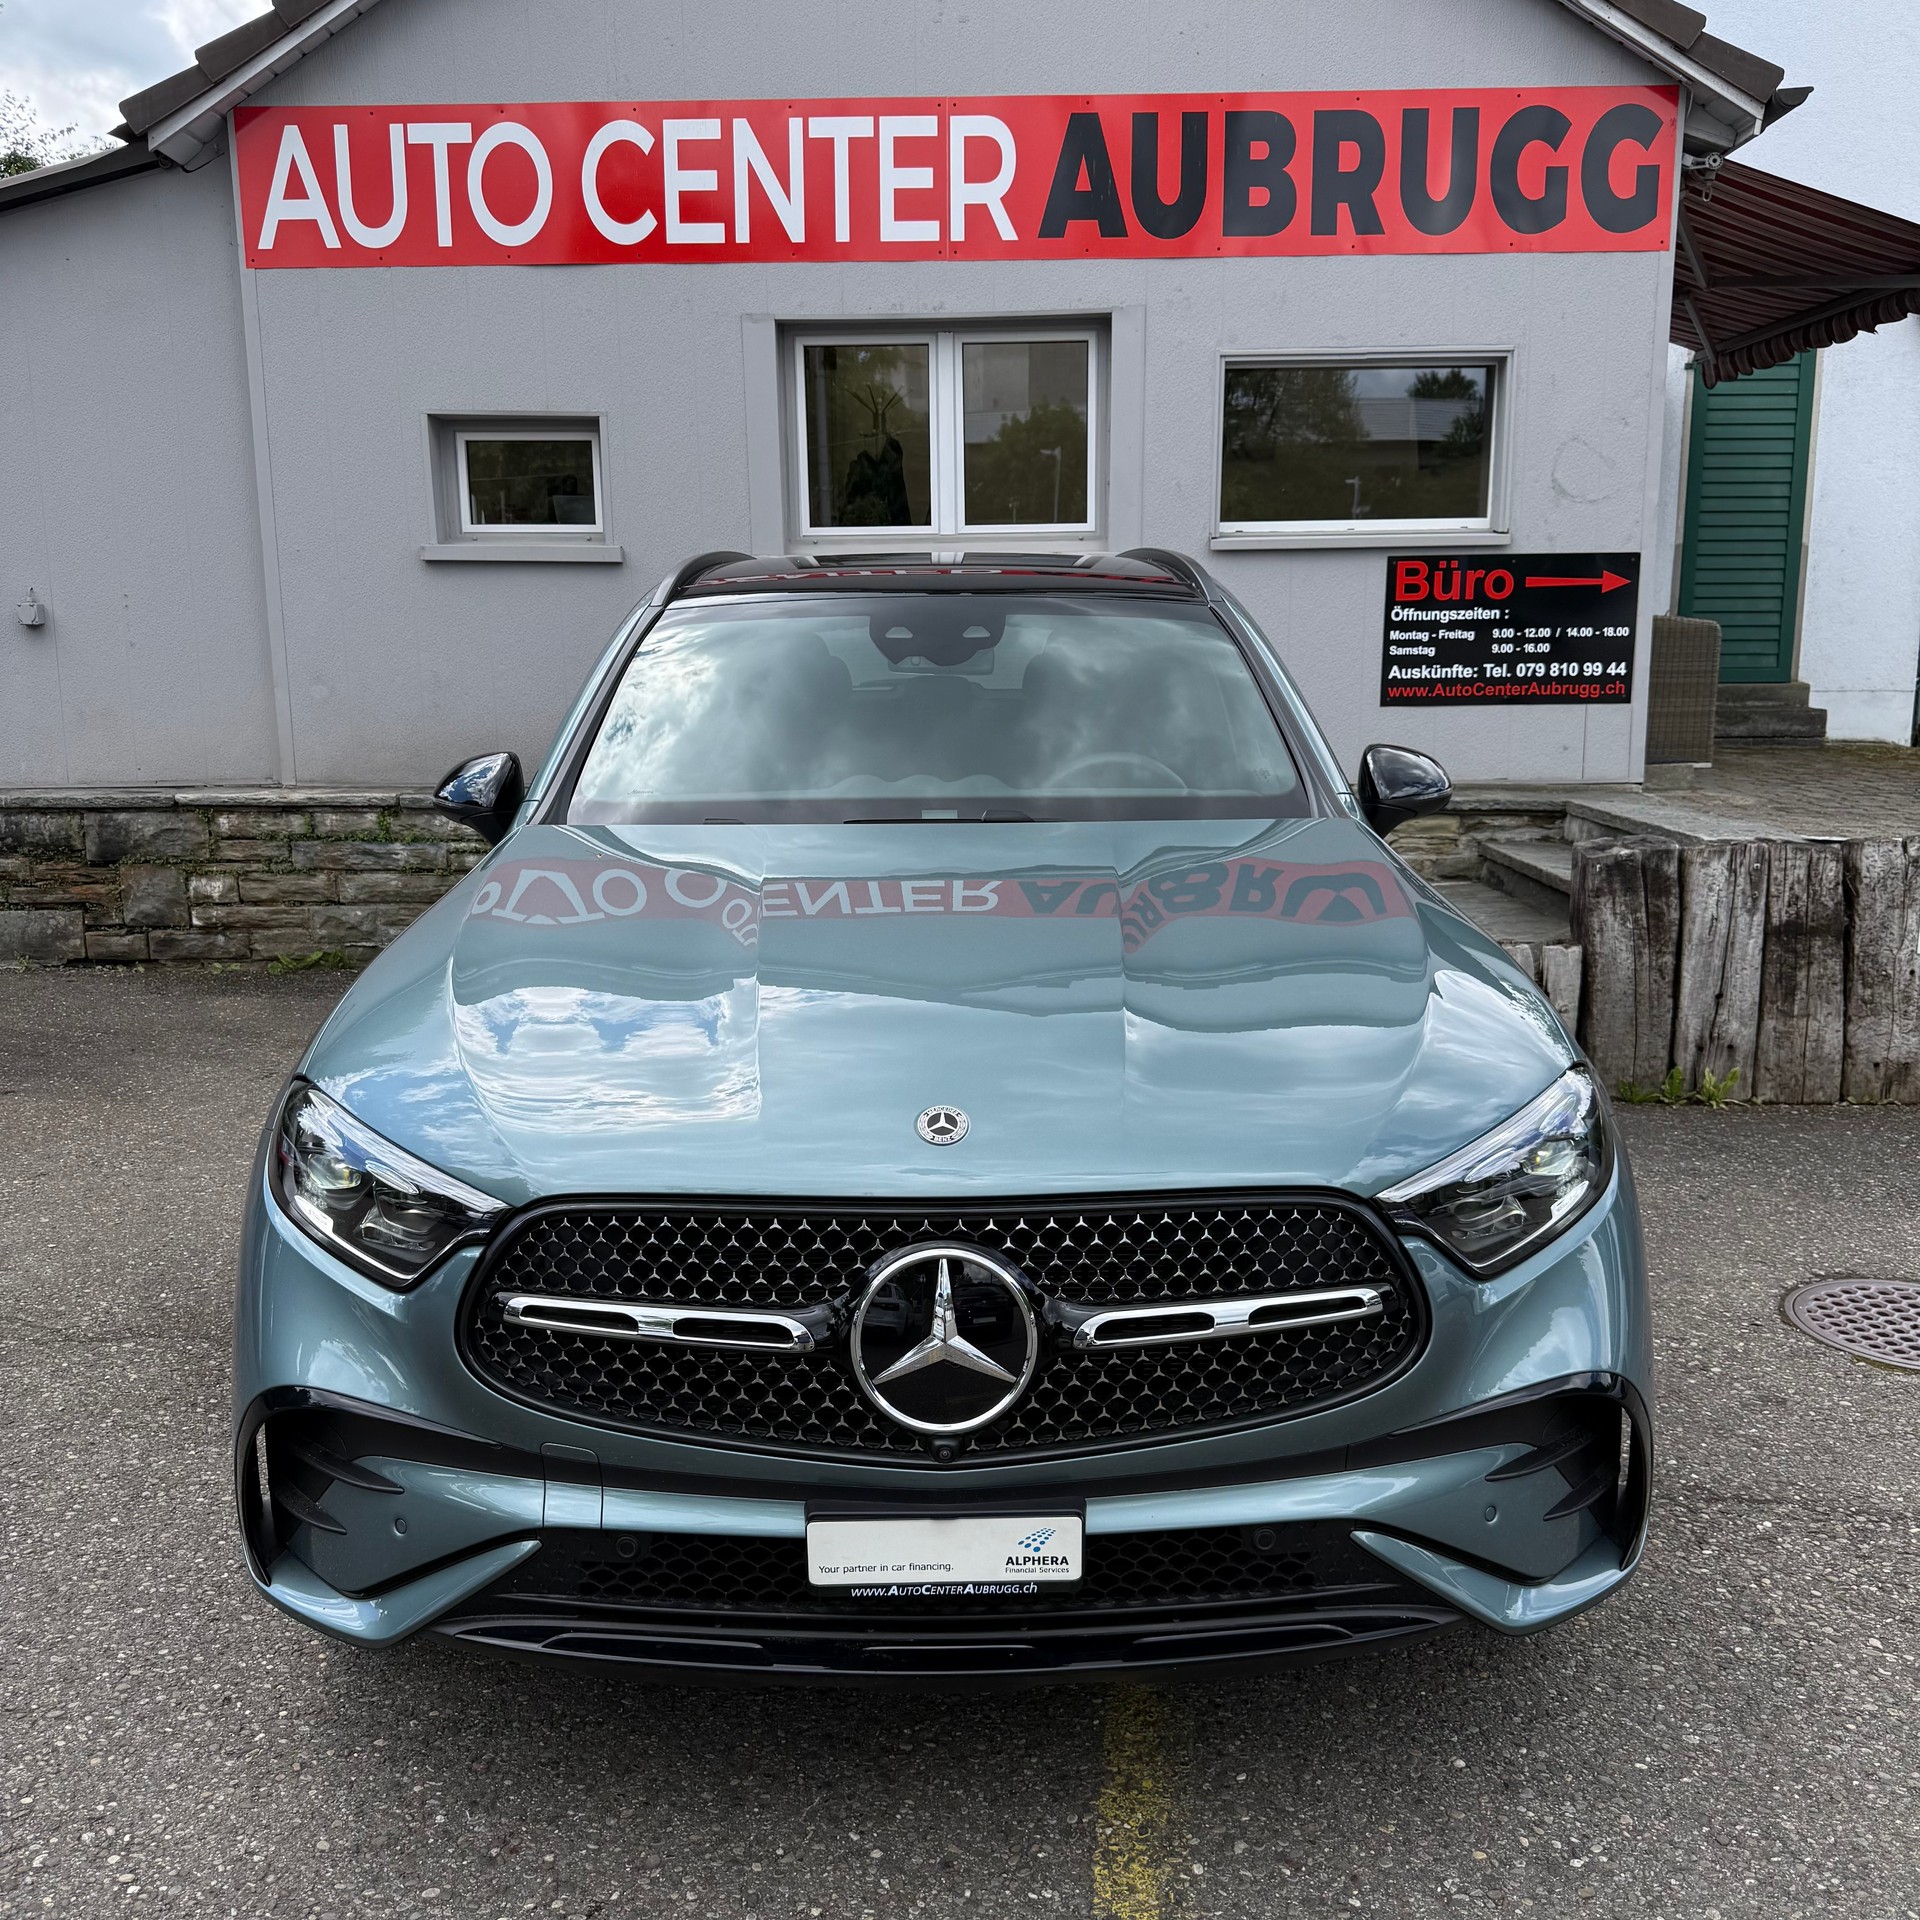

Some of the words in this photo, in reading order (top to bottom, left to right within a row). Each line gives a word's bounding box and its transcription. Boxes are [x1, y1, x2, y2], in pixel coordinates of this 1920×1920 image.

[257, 121, 553, 250] AUTO
[581, 113, 1019, 247] CENTER
[1037, 103, 1663, 240] AUBRUGG
[1395, 560, 1515, 602] Büro
[1391, 605, 1500, 623] Öffnungszeiten
[1389, 630, 1430, 642] Montag
[1439, 629, 1476, 641] Freitag
[1492, 628, 1515, 639] 9.00
[1524, 627, 1551, 638] 12.00
[1566, 627, 1593, 638] 14.00
[1603, 626, 1630, 637] 18.00
[1389, 645, 1436, 657] Samstag
[1491, 643, 1515, 654] 9.00
[1523, 643, 1550, 654] 16.00
[1388, 663, 1479, 680] Auskünfte:
[1484, 663, 1511, 678] Tel.
[1516, 663, 1545, 678] 079
[1550, 663, 1579, 677] 810
[1583, 662, 1603, 676] 99
[1606, 661, 1627, 676] 44
[1388, 680, 1626, 698] www.AutoCenterAubrugg.ch
[818, 1564, 840, 1574] Your
[842, 1563, 878, 1575] partner
[880, 1563, 889, 1572] in
[891, 1564, 905, 1572] car
[908, 1561, 954, 1573] financing.
[1005, 1555, 1069, 1567] ALPHERA
